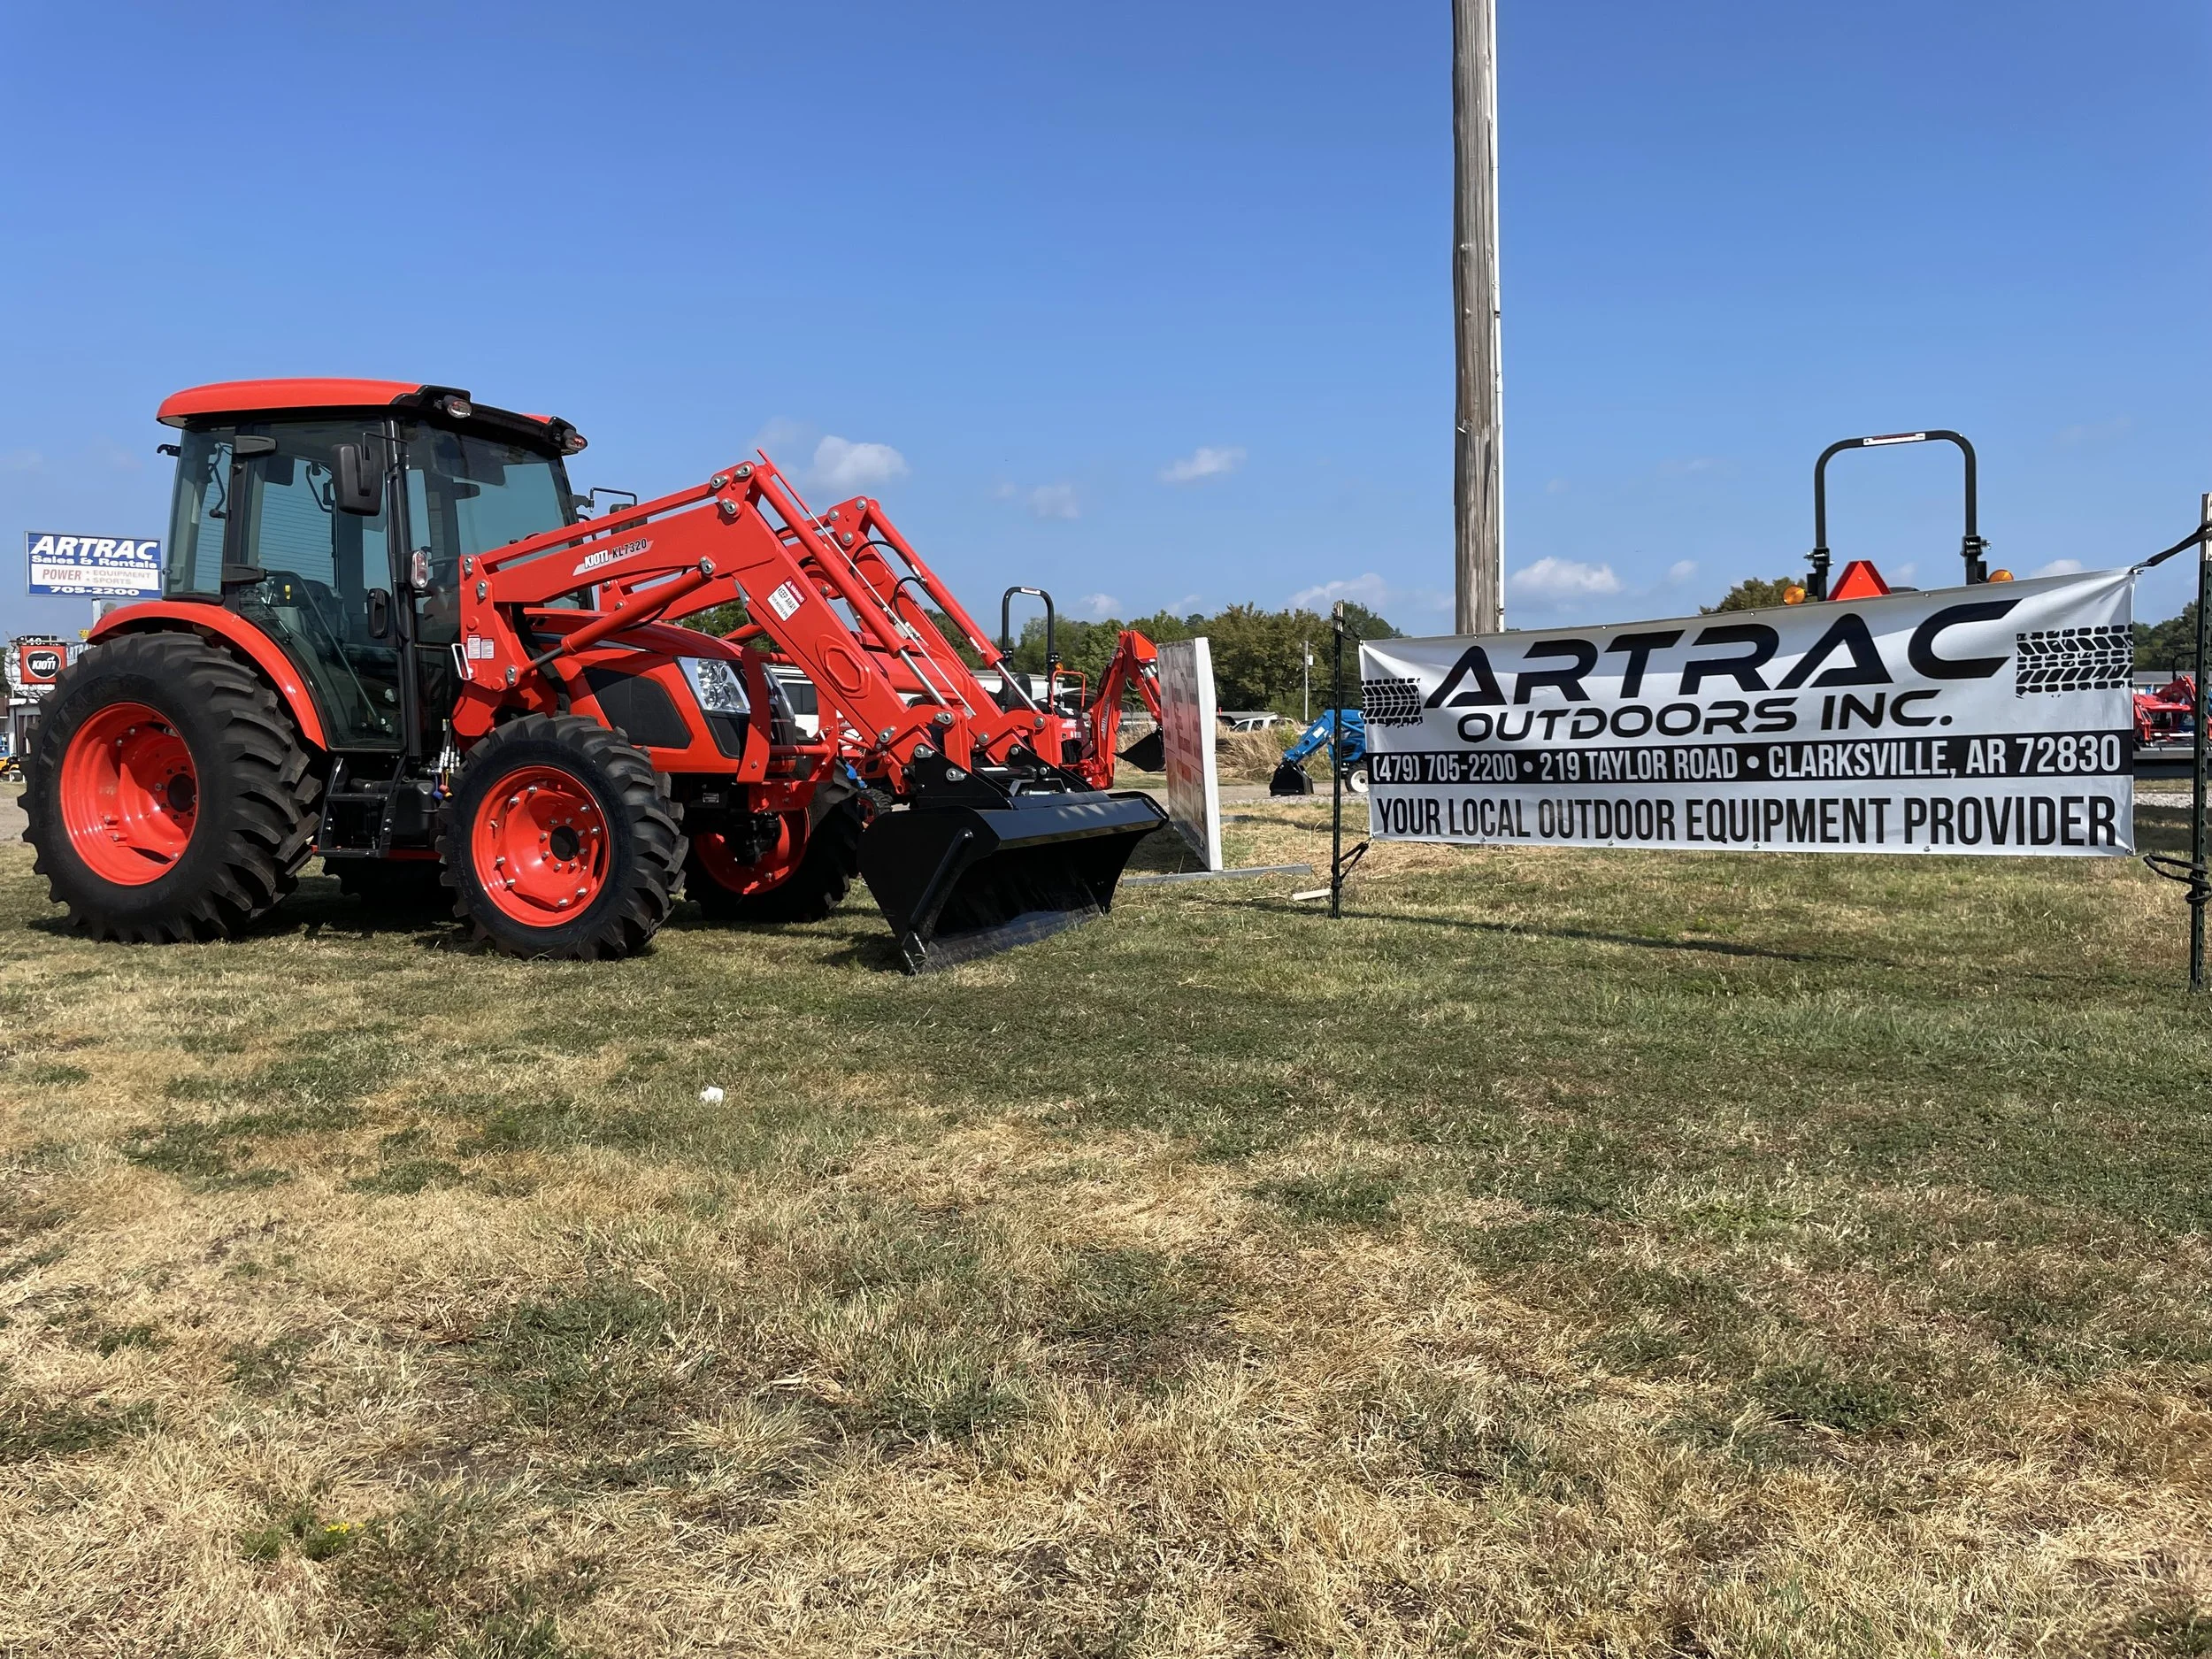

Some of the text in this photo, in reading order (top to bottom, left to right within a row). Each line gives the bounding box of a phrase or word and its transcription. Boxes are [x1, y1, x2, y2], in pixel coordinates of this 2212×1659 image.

[30, 535, 157, 560] ARTRAC
[584, 538, 648, 569] KIOTI KL7320
[31, 555, 157, 569] Sales & Rentals
[93, 569, 151, 579] EQUIPMENT
[42, 568, 82, 581] POWER
[50, 586, 140, 596] 705-2200
[778, 588, 796, 611] KEEP AWAY
[32, 656, 56, 670] KIOTI
[1424, 598, 2023, 708] ARTRAC
[1457, 689, 1953, 742] OUTDOORS INC.
[1372, 734, 2121, 782] (479) 705-2200 219 TAYLOR ROAD CLARKSVILLE, AR 72830
[1377, 796, 2116, 846] YOUR LOCAL OUTDOOR EQUIPMENT PROVIDER
